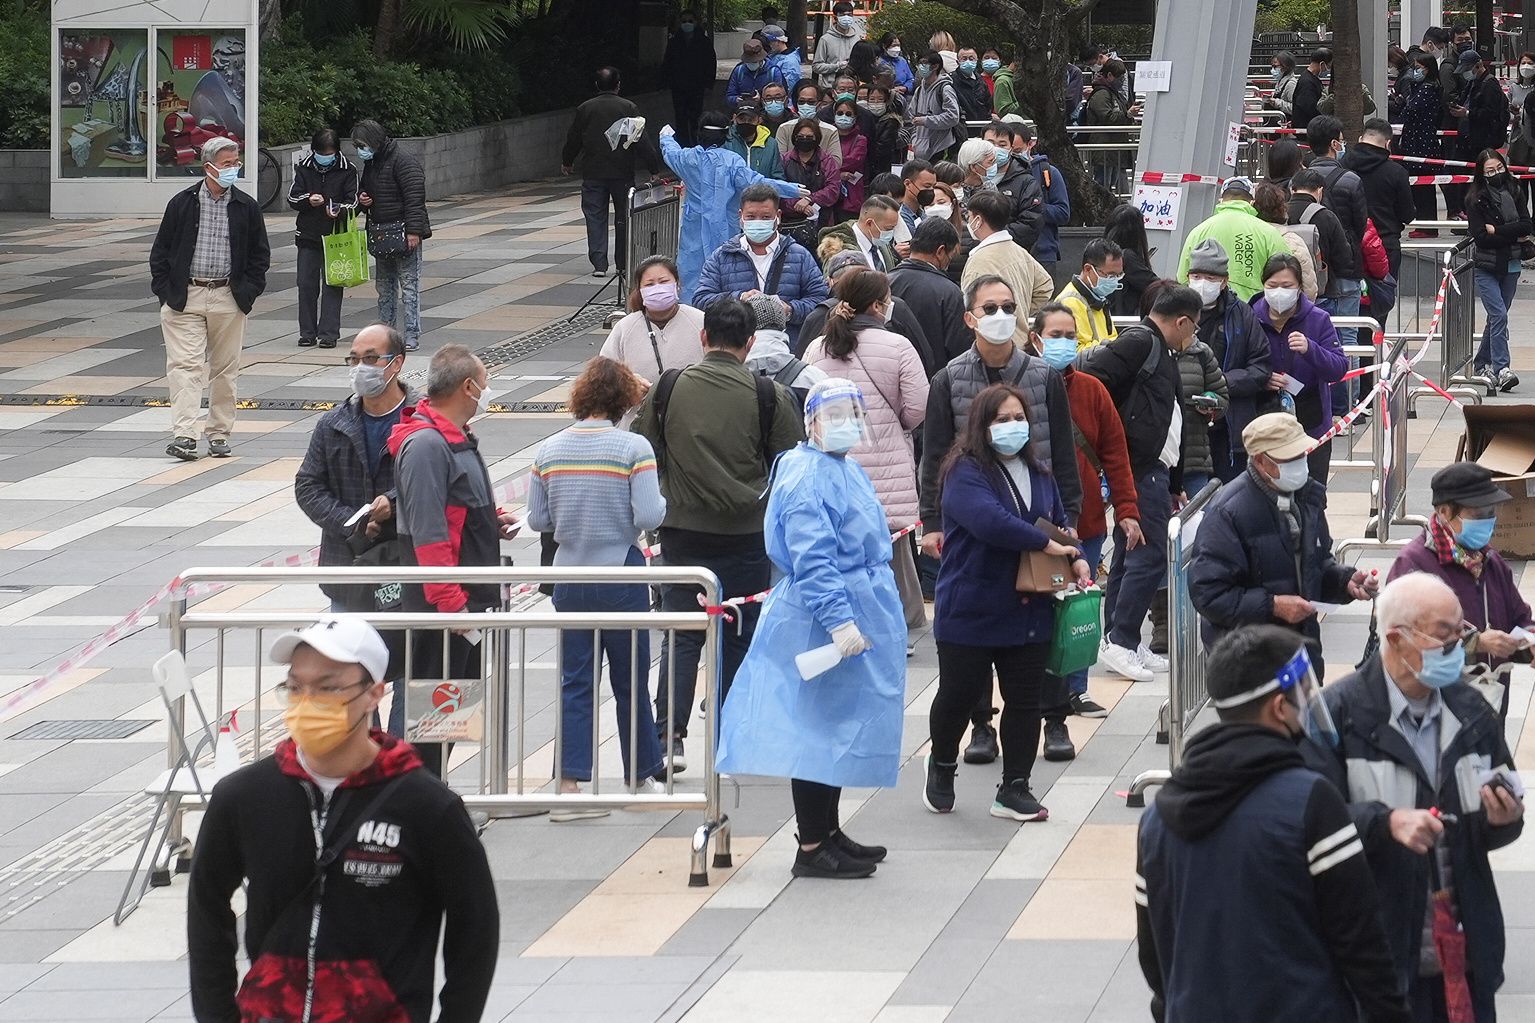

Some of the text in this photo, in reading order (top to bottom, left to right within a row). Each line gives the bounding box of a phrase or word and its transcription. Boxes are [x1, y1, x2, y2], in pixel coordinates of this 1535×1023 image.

[1140, 199, 1171, 216] 加油
[1234, 233, 1244, 265] water
[1244, 233, 1255, 278] watsons
